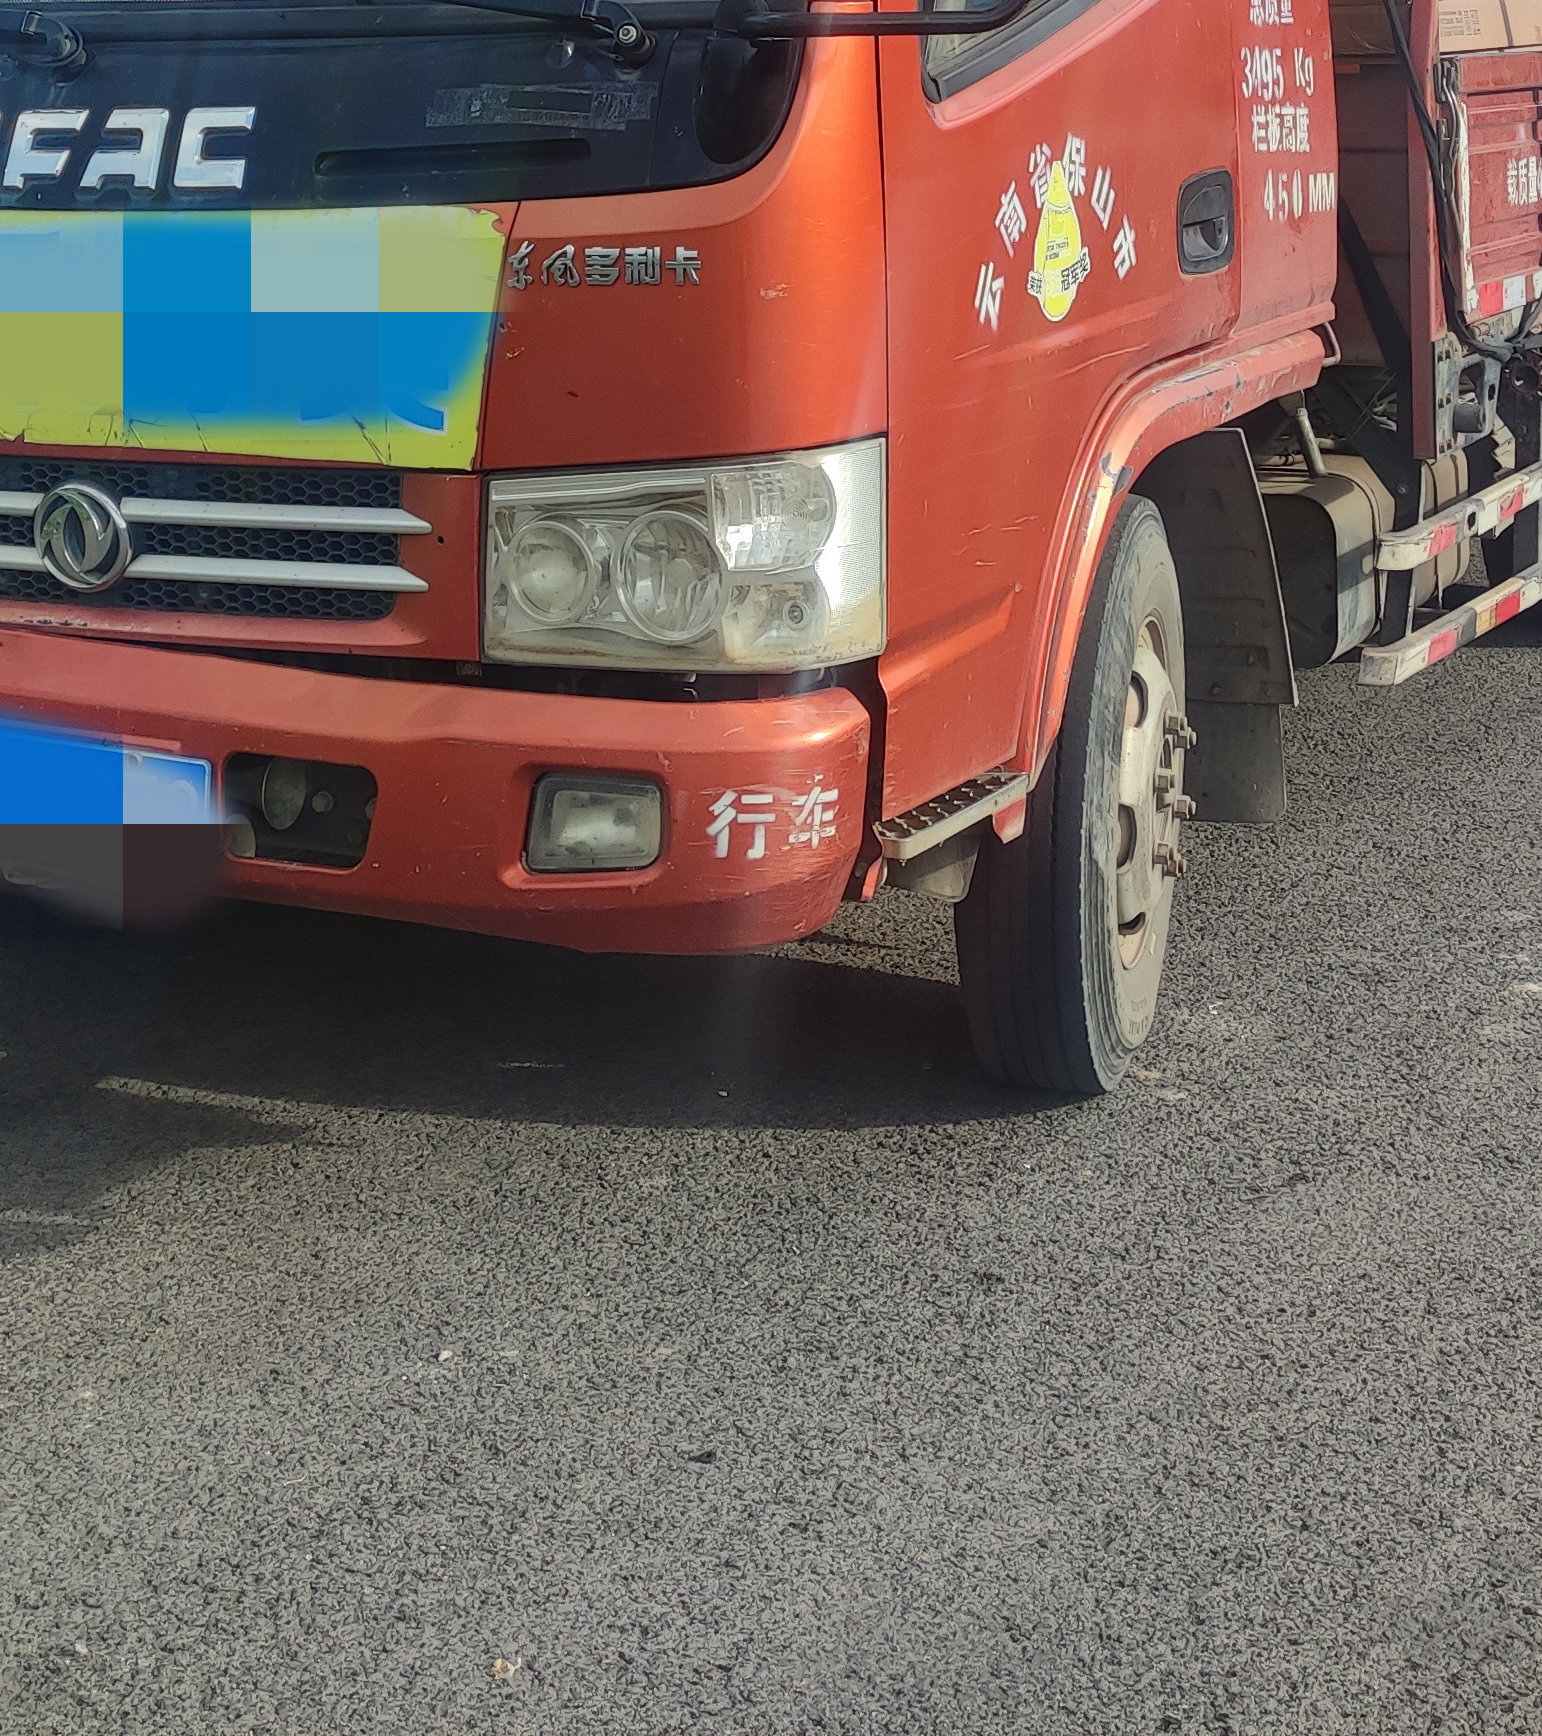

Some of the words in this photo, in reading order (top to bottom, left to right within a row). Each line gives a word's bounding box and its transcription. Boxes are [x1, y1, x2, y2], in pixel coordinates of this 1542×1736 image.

[1293, 47, 1315, 97] Kg
[1251, 101, 1310, 154] 栏板高度
[1263, 167, 1303, 223] 450
[1309, 171, 1338, 214] MM
[973, 130, 1138, 335] 云南省保山市
[507, 240, 703, 291] 东风多利卡
